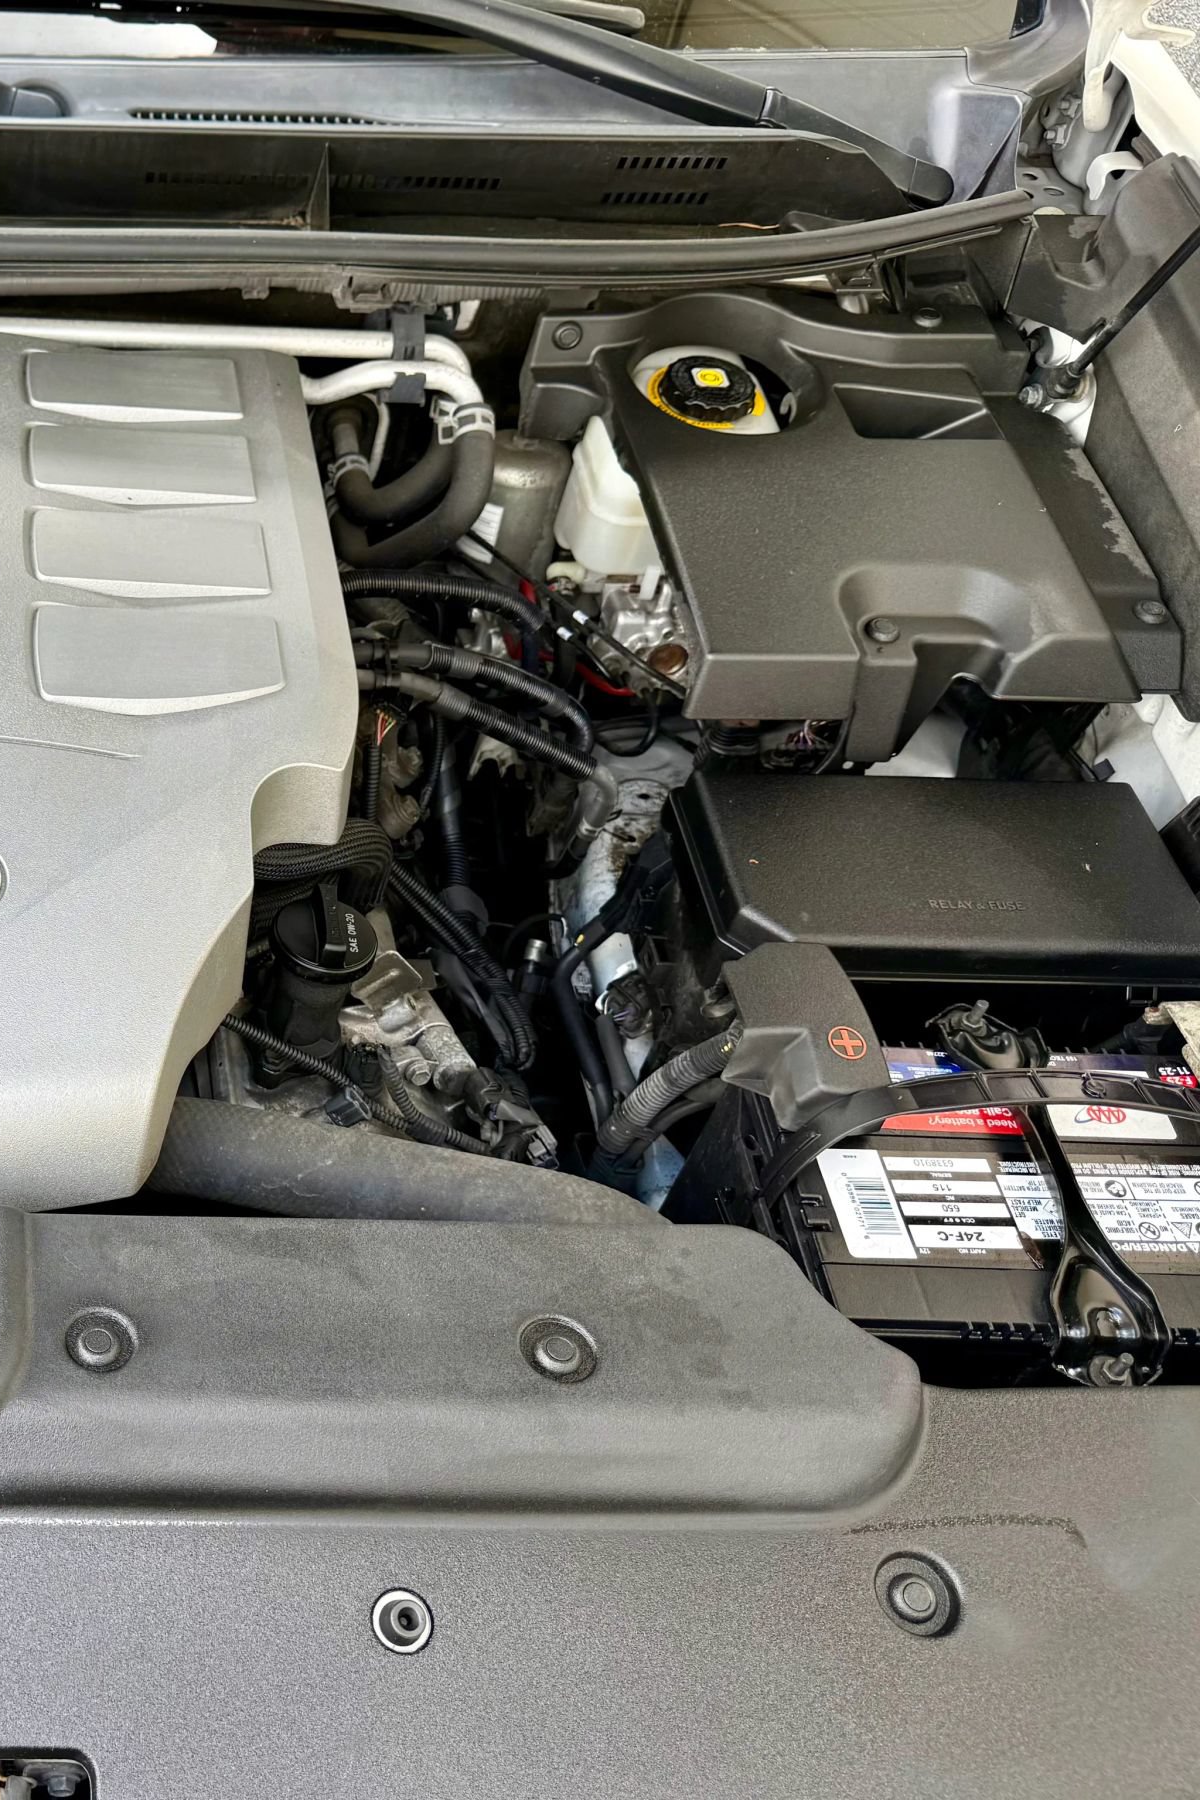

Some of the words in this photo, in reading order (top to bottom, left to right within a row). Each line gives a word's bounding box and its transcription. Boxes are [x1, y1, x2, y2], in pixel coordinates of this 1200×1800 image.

[928, 899, 973, 910] RELAY
[976, 902, 986, 910] &
[987, 900, 1026, 911] FUSE
[344, 913, 357, 935] 0W-20
[349, 937, 359, 953] SAE
[1158, 1066, 1190, 1075] 11-25
[983, 1107, 1012, 1116] Call:
[1087, 1105, 1122, 1124] AAA
[928, 1116, 975, 1127] battery?
[987, 1119, 1017, 1128] Need
[913, 1159, 954, 1167] 6338910
[933, 1183, 952, 1192] 115
[942, 1204, 960, 1212] 650
[937, 1231, 985, 1242] 24F-C
[1112, 1242, 1188, 1251] DANGER/PO
